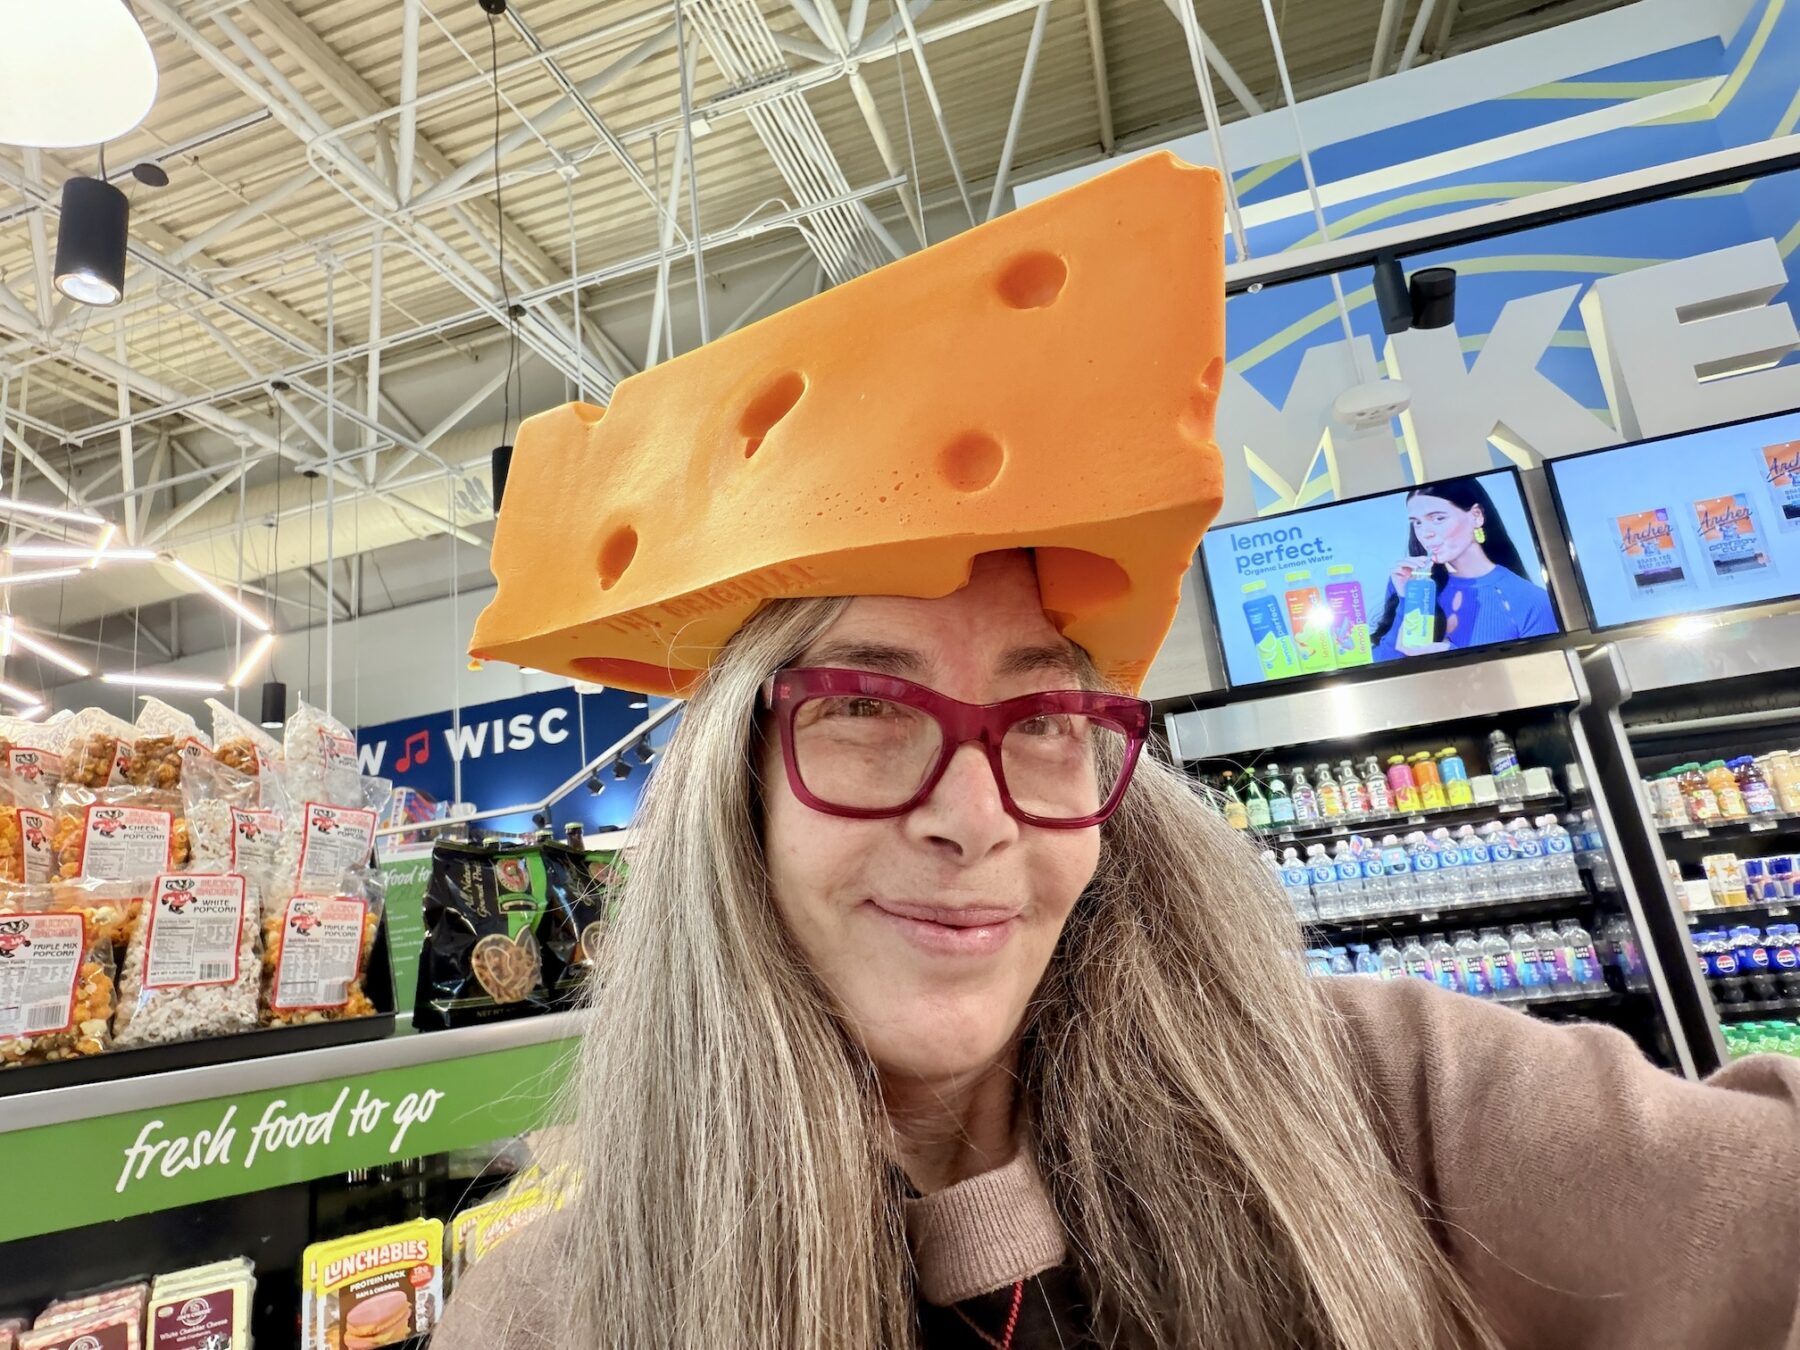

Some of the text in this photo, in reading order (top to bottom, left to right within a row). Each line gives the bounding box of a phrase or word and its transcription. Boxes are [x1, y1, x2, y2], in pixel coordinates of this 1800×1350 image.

[1221, 237, 1800, 519] MKE
[1697, 505, 1753, 536] Archer
[1230, 527, 1302, 552] lemon
[1620, 522, 1673, 551] Archer
[1236, 537, 1332, 574] perfect.
[1244, 555, 1333, 576] Organic Lemon Water
[1294, 793, 1305, 818] hint
[1349, 785, 1361, 811] hint
[1374, 782, 1386, 808] hint
[123, 832, 165, 841] POPCORN
[33, 943, 60, 951] TRIPLE
[115, 1086, 444, 1194] fresh food to go
[324, 1239, 429, 1288] LUNCHABLES
[349, 1275, 384, 1293] PROTEIN
[383, 1270, 407, 1284] PACK
[355, 1289, 370, 1300] HAM
[159, 1318, 229, 1341] White Cheddar Cheese
